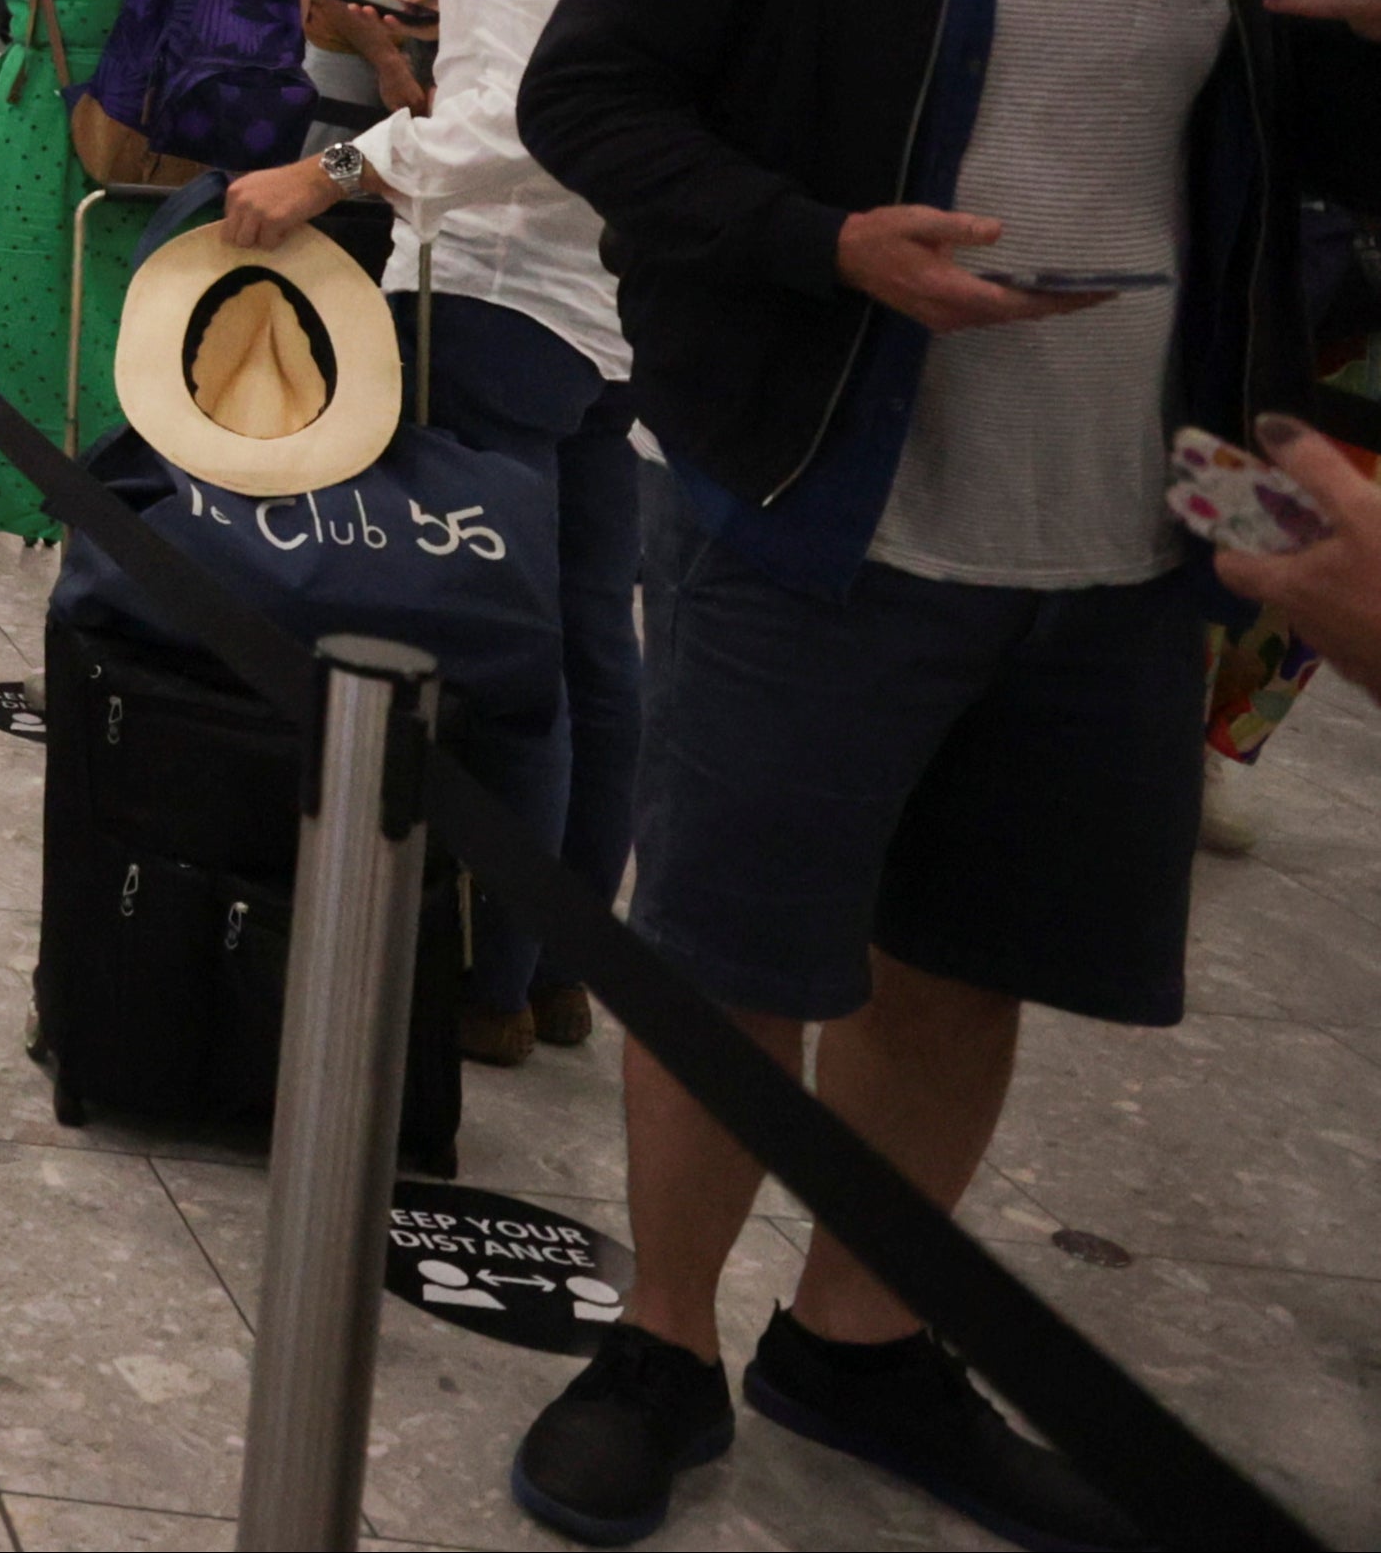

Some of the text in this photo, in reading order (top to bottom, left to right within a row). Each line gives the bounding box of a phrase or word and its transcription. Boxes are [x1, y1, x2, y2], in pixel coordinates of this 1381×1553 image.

[255, 489, 388, 551] Club
[408, 498, 507, 561] 55
[390, 1209, 589, 1247] EEP YOUR
[390, 1229, 596, 1268] DISTANCE
